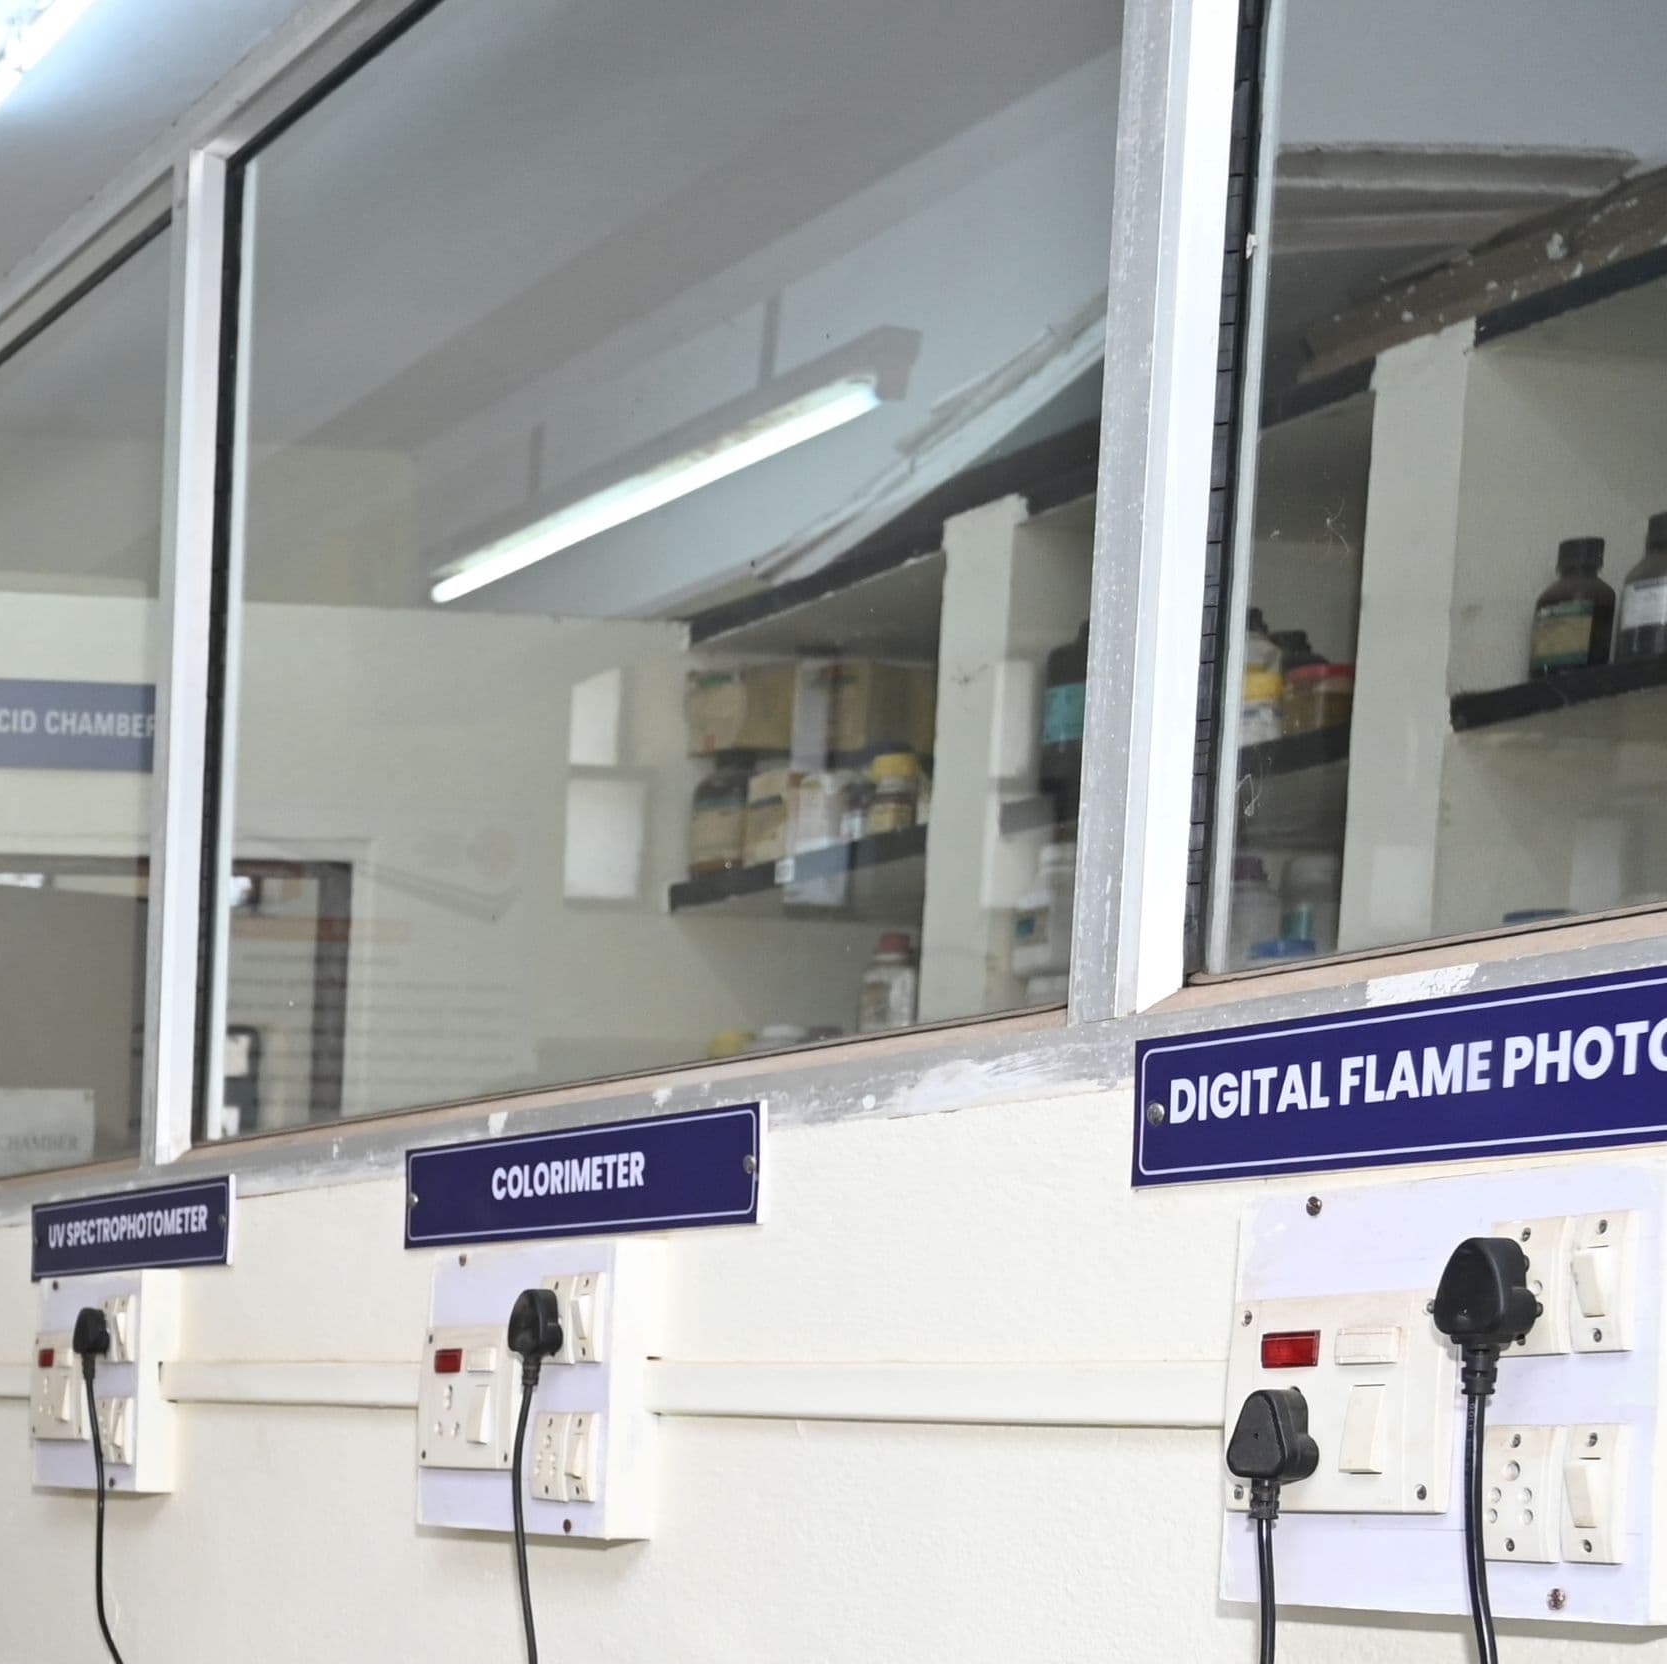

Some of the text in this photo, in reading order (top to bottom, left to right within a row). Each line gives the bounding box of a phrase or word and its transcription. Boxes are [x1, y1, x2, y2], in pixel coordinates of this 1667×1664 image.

[1170, 1060, 1329, 1124] DIGITAL
[1339, 1040, 1492, 1105] FLAME
[492, 1151, 645, 1200] COLORIMETER
[48, 1205, 208, 1249] UV SPECTROPHOTOMETER
